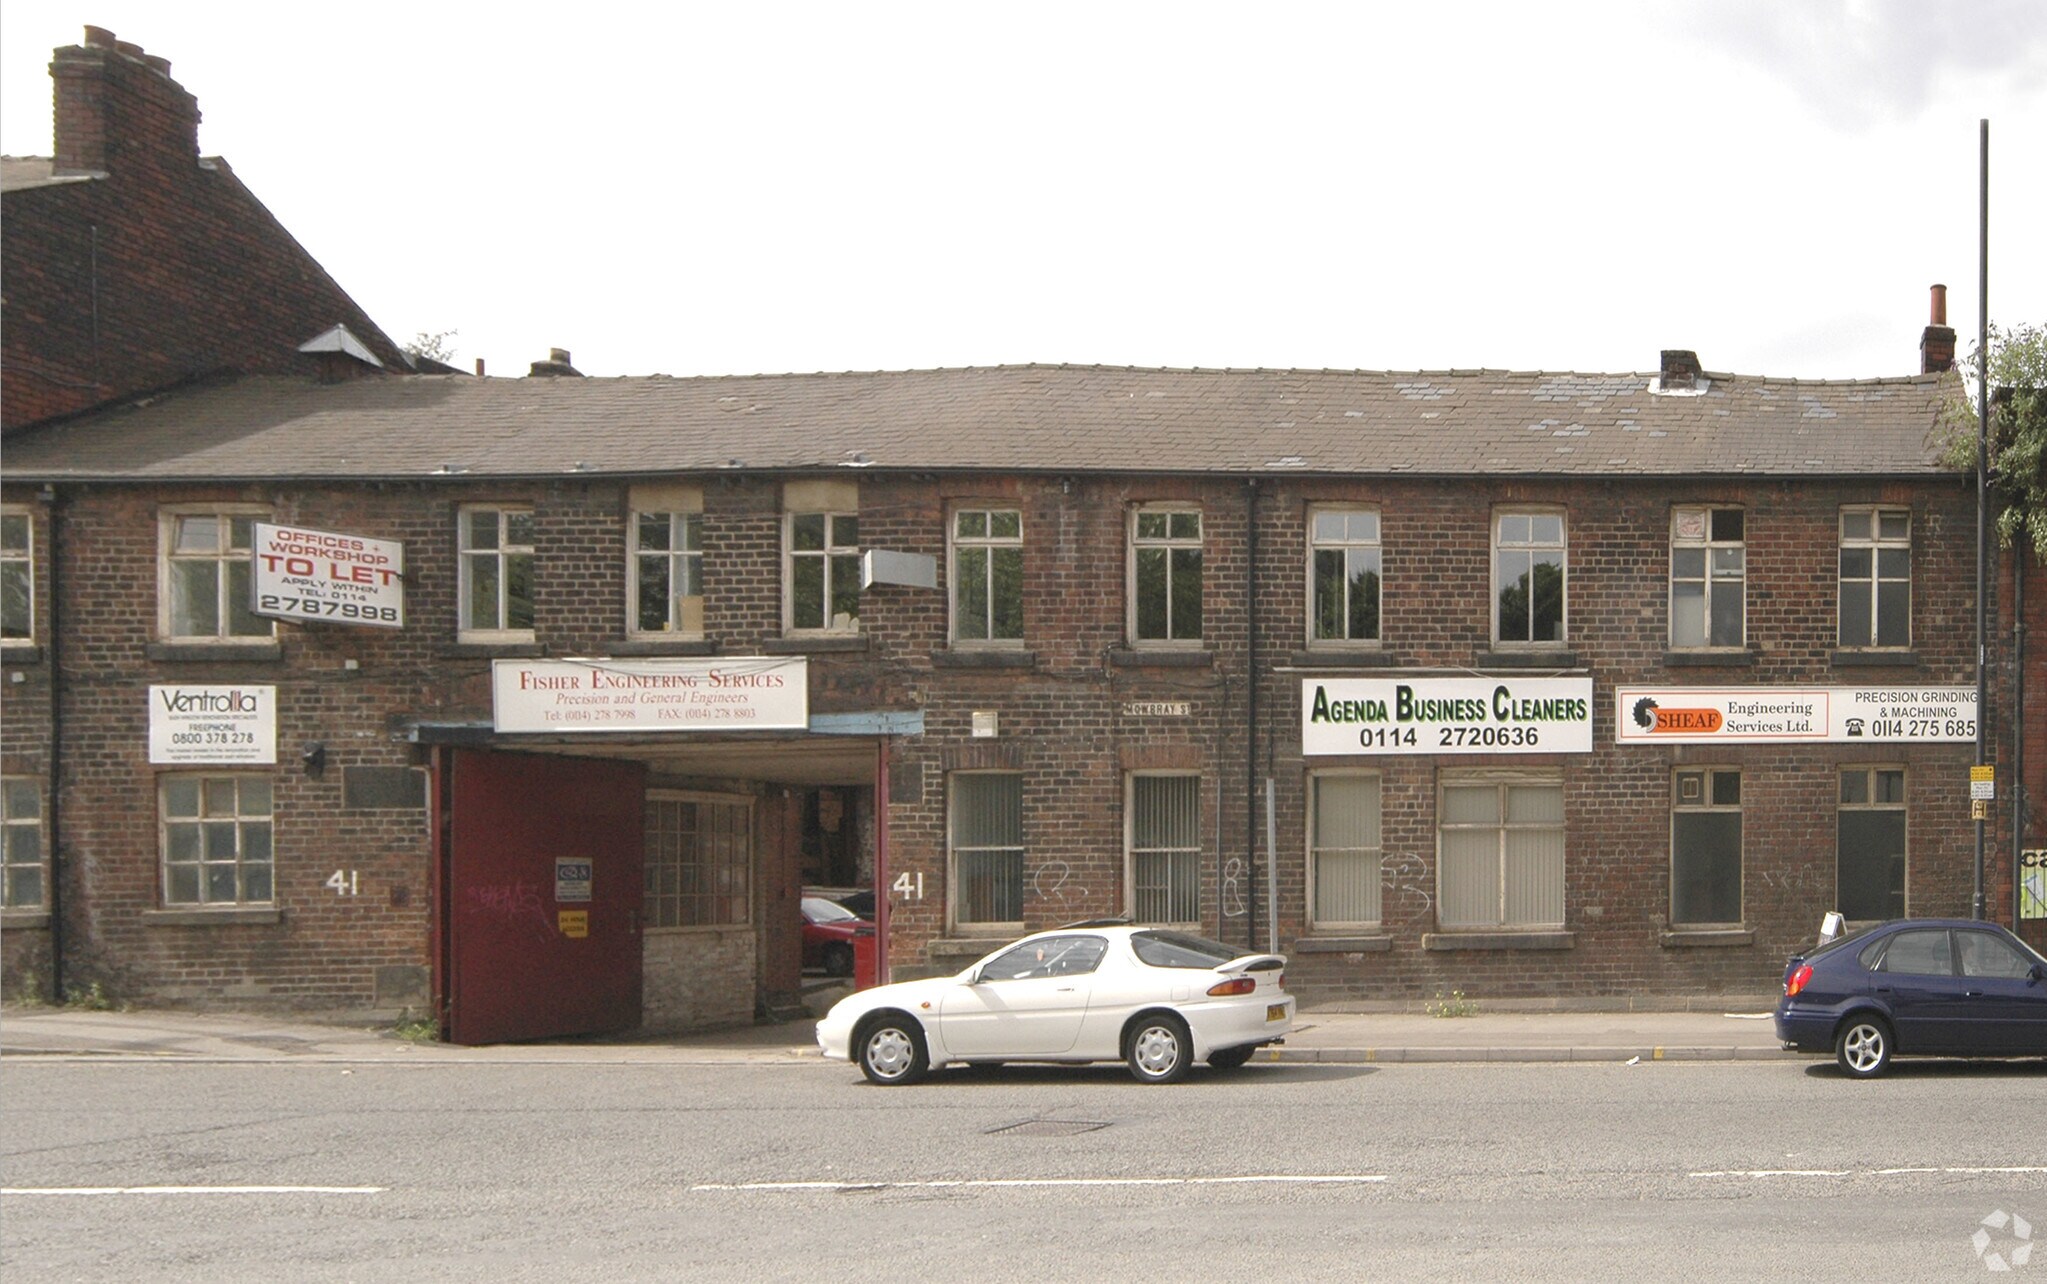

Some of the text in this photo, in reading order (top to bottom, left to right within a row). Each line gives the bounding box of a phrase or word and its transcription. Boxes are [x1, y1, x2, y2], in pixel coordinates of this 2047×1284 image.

[276, 530, 364, 551] OFFICES
[269, 541, 389, 565] WORKSHOP
[260, 554, 397, 586] TO LET
[281, 577, 379, 594] APPLY WITHIN
[297, 588, 367, 602] TEL: 0114
[260, 595, 398, 621] 2787998
[520, 669, 784, 690] FISHER ENGINEERING SERVICES
[161, 690, 257, 712] Ventrolla
[556, 691, 749, 706] Precision and General Engineers
[1310, 685, 1588, 723] AGENDA BUSINESS CLEANERS
[1855, 692, 1978, 703] PRECISION GRINDING
[544, 709, 636, 722] Tel: (0114) 278 7998
[657, 708, 681, 719] FAX:
[685, 708, 711, 720] (0114)
[715, 708, 731, 718] 278
[1727, 702, 1813, 718] Engineering
[1879, 707, 1957, 718] & MACHINING
[189, 724, 236, 732] FREEPHONE
[1657, 712, 1719, 729] SHEAF
[1726, 719, 1813, 733] Services Ltd.
[1872, 720, 1976, 737] 0114 275 685
[172, 733, 254, 744] 0800 378 278
[1360, 727, 1539, 747] 0114 2720636
[326, 869, 358, 895] 41
[893, 872, 923, 899] 41
